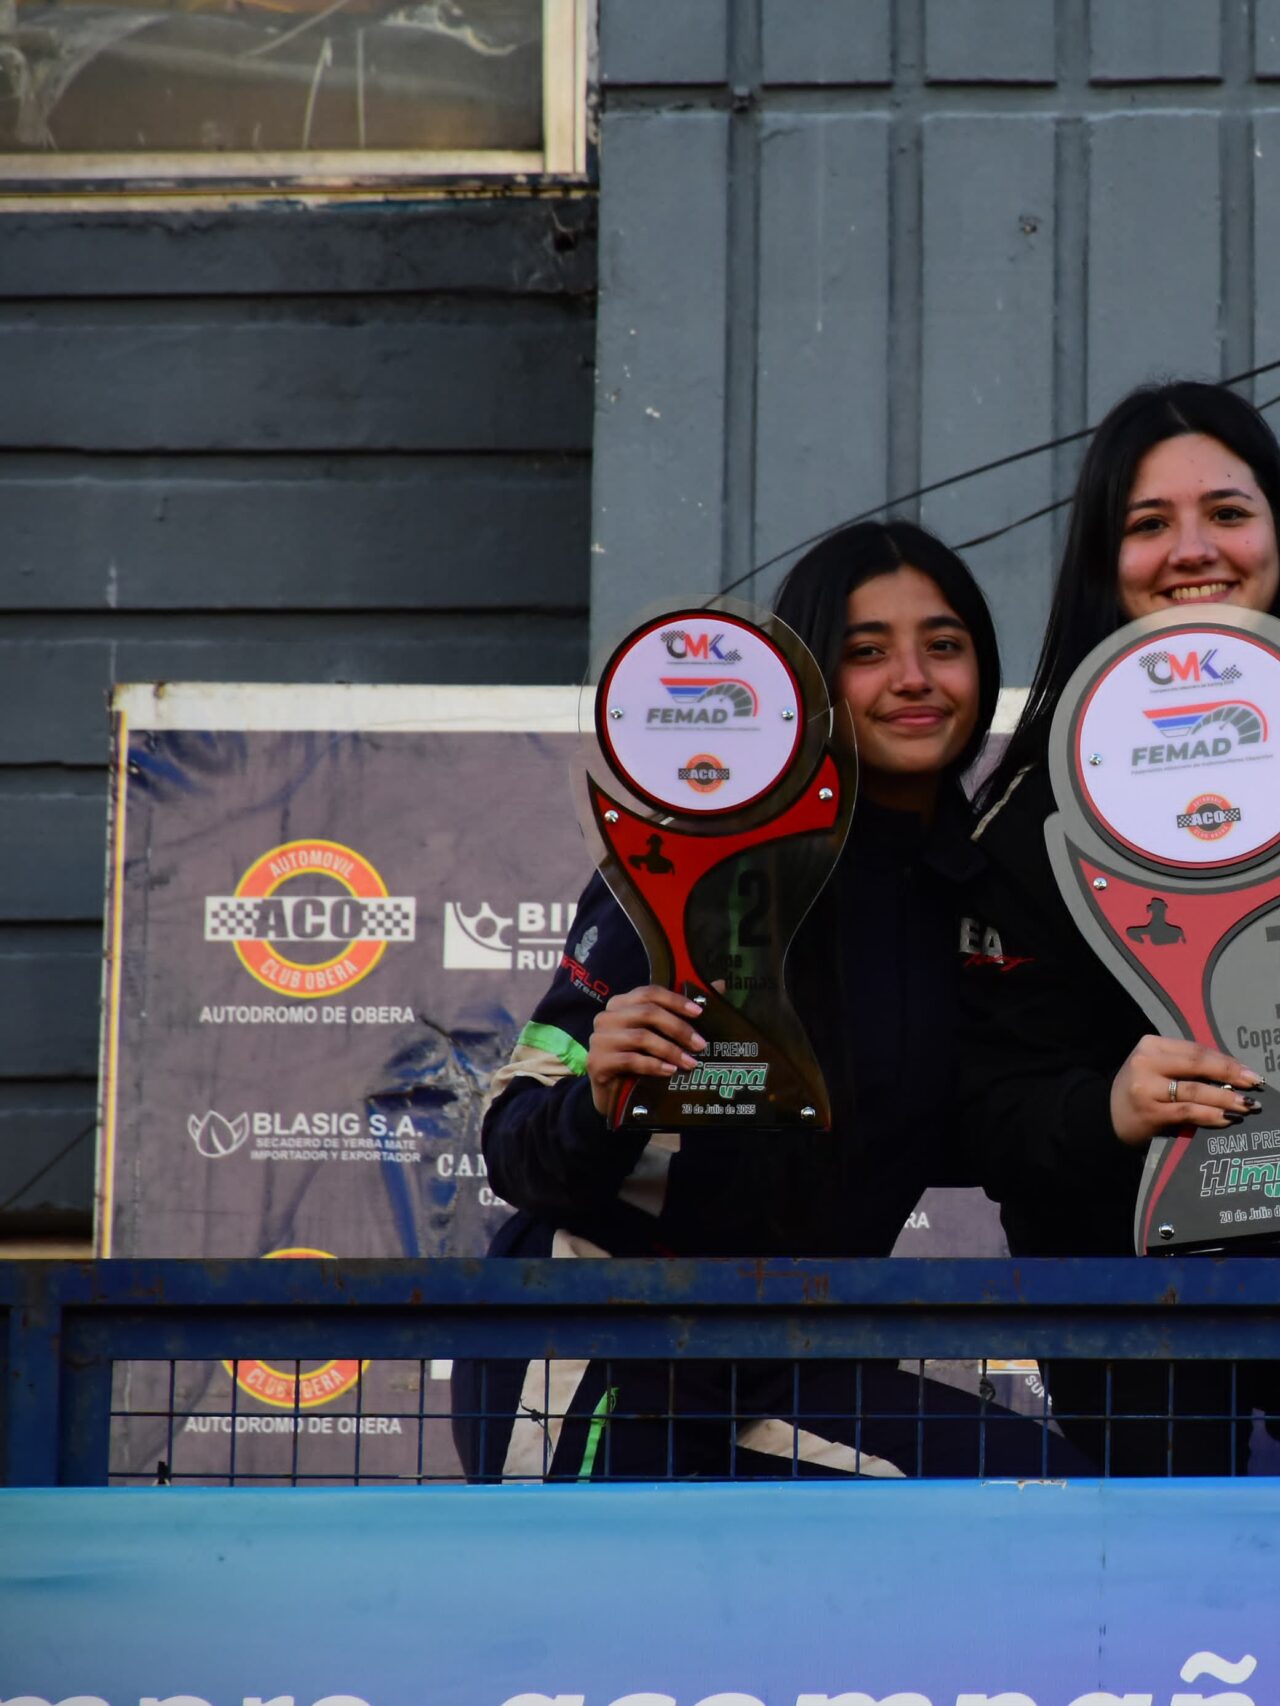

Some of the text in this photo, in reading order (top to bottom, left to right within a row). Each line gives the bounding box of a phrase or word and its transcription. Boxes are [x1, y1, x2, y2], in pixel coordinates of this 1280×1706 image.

[646, 707, 728, 724] FEMAD
[1131, 737, 1232, 767] FEMAD
[1189, 809, 1226, 826] ACO
[268, 849, 355, 878] AUTOMOVIL
[254, 898, 365, 939] ACO
[260, 959, 358, 990] CLUB OBERA
[199, 1006, 415, 1024] AUTODROMO DE OBERA
[713, 1041, 758, 1057] PREMIO
[253, 1112, 424, 1138] BLASIG S.A.
[256, 1138, 416, 1150] SECADERO DE YERBA MATE
[1207, 1133, 1249, 1156] GRAN
[331, 1151, 338, 1160] Y
[341, 1151, 421, 1162] EXPORTADOR
[1220, 1211, 1233, 1224] 20
[1234, 1210, 1247, 1222] de
[1249, 1206, 1273, 1220] Julio
[184, 1416, 302, 1433] AUTODROMO
[308, 1417, 333, 1434] DE
